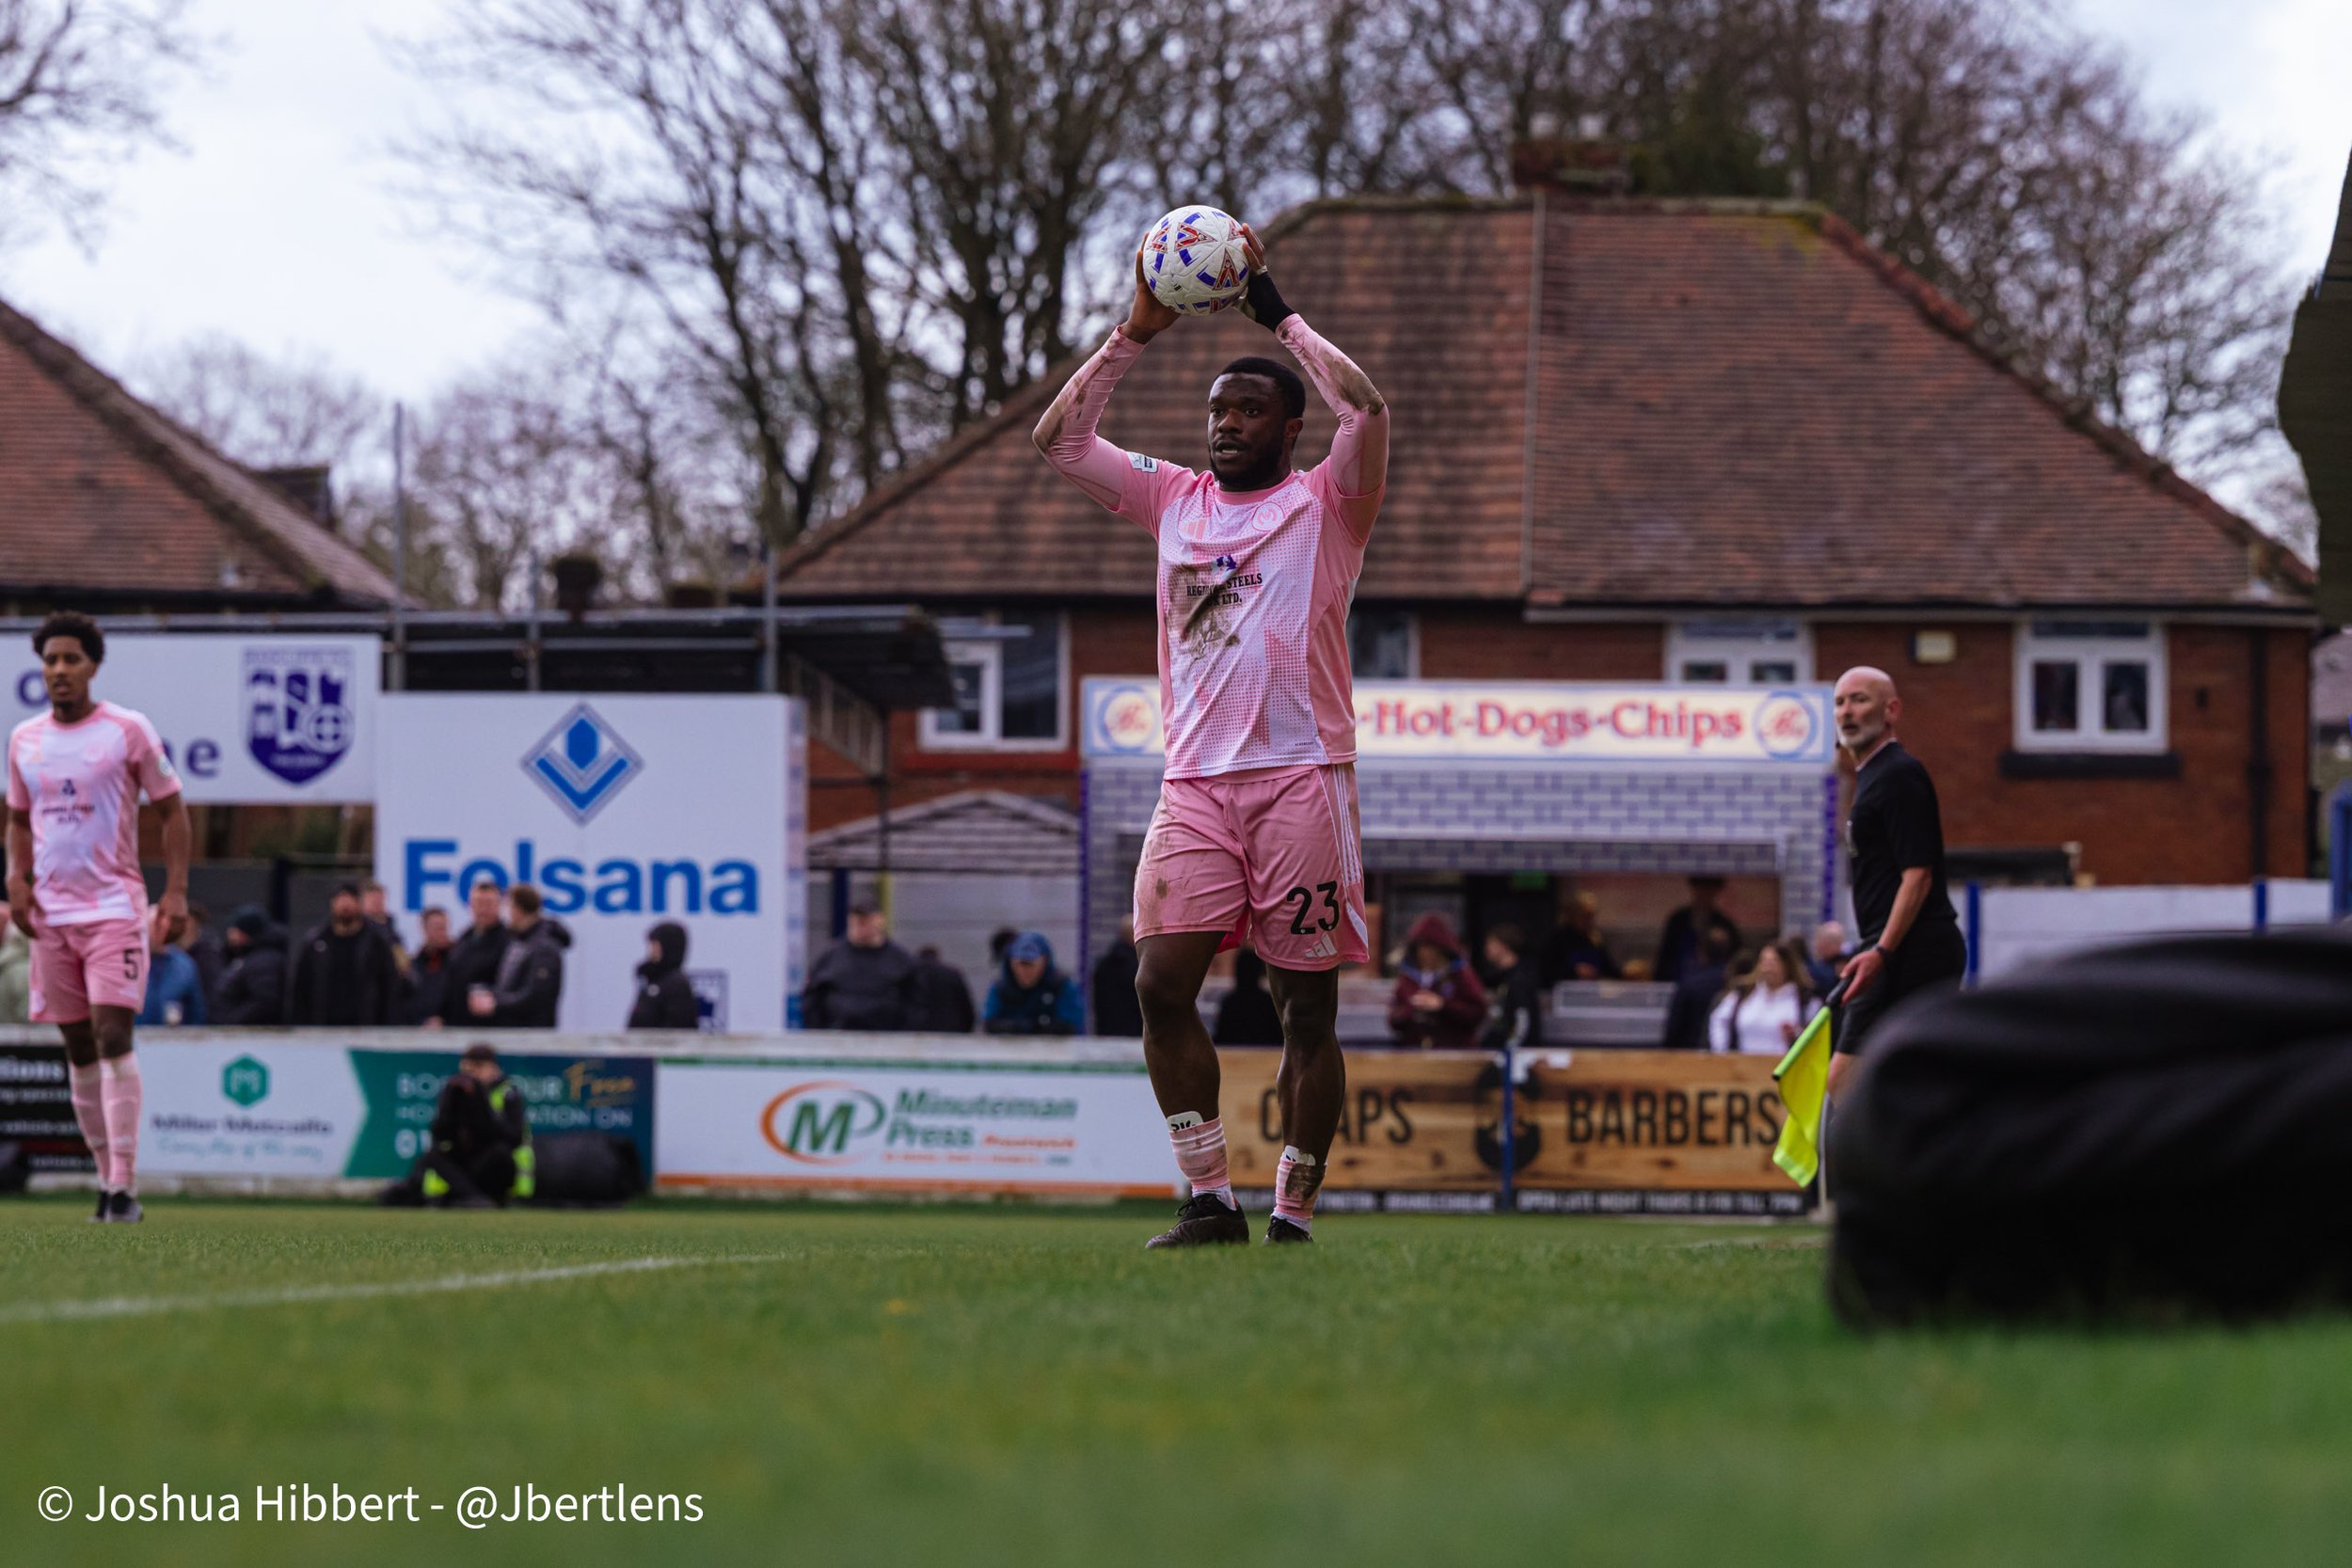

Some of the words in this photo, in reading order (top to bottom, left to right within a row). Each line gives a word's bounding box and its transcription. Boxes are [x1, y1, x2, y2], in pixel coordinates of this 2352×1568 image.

[1227, 573, 1263, 589] STEELS
[1286, 880, 1340, 935] 23
[124, 948, 140, 980] 5
[894, 1088, 1078, 1118] Minuteman
[1566, 1089, 1782, 1146] BARBERS
[885, 1117, 975, 1149] Press
